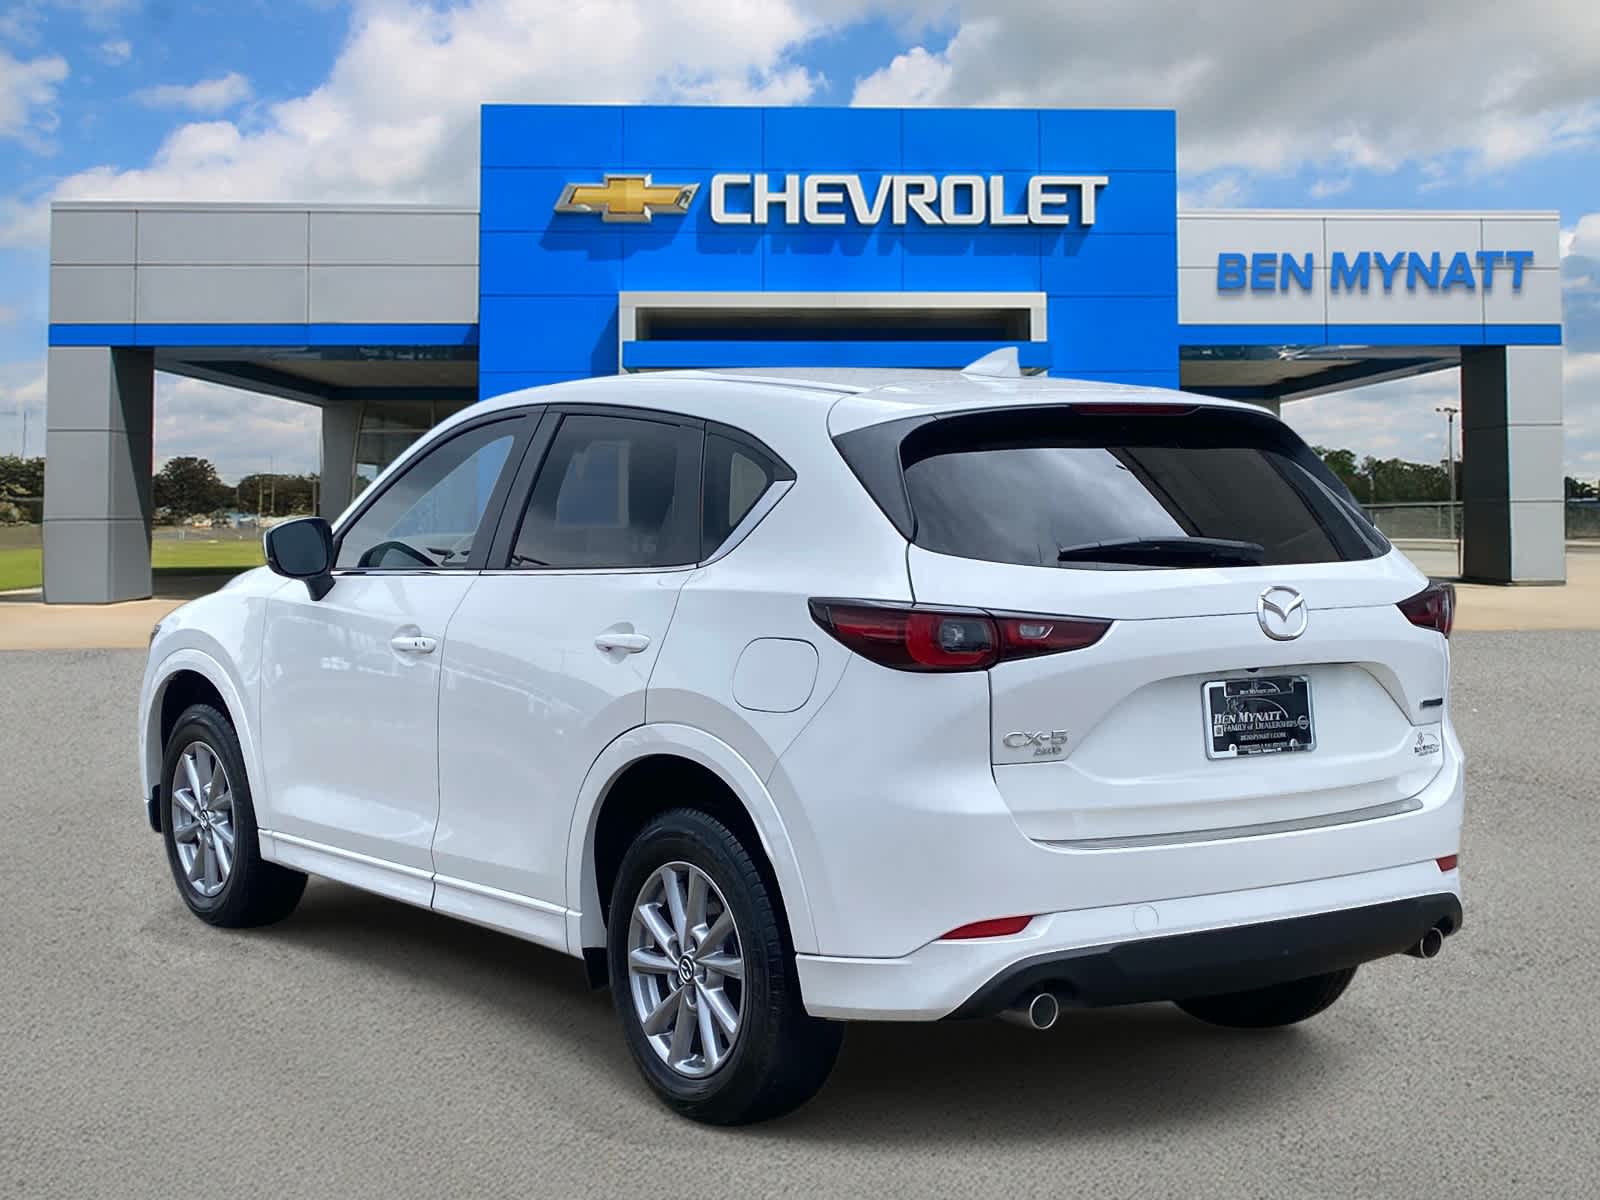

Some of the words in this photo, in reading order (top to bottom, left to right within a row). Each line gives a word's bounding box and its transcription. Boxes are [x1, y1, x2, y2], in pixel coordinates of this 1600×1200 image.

[709, 173, 1110, 226] CHEVROLET
[1217, 252, 1313, 290] BEN
[1330, 250, 1535, 290] MYNATT
[1214, 713, 1236, 724] BEN
[1238, 711, 1282, 723] MYNATT
[1003, 730, 1068, 748] CX-5
